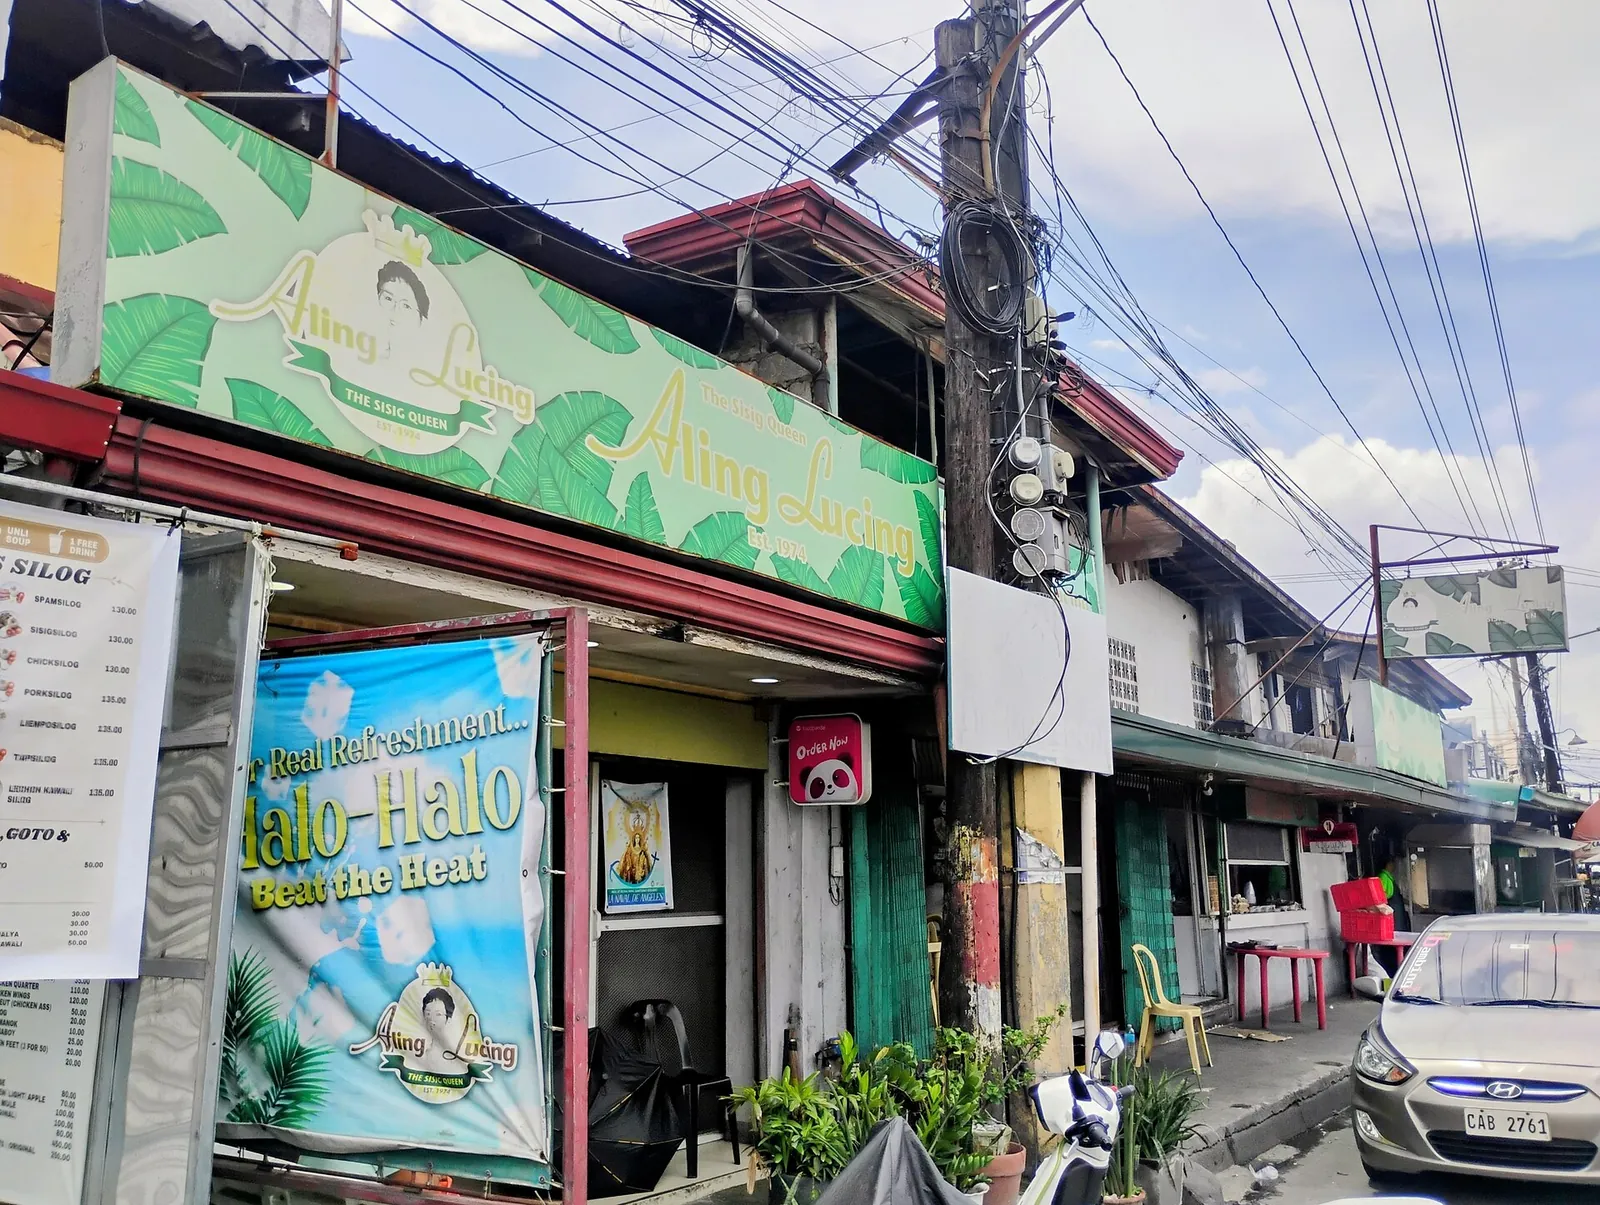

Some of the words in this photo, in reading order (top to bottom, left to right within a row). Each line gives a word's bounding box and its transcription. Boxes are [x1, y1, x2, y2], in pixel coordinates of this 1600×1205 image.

[213, 255, 377, 365] Aling
[408, 323, 534, 421] Lucing
[345, 387, 371, 408] THE
[374, 399, 406, 420] SISIG
[408, 411, 448, 431] QUEEN
[701, 382, 729, 411] The
[731, 399, 764, 430] Sisig
[767, 415, 808, 447] Queen
[396, 425, 421, 441] 1974
[586, 367, 770, 525] Aling
[777, 437, 914, 577] Lucing
[7, 526, 29, 537] UNLI
[6, 535, 31, 546] SOUP
[70, 537, 75, 546] 1
[77, 538, 99, 549] FREE
[747, 526, 773, 551] Est.
[777, 536, 808, 563] 1974
[70, 546, 97, 557] DRINK
[10, 558, 92, 585] SILOG
[34, 595, 82, 608] SPAMSILOG
[112, 606, 137, 615] 130.00
[30, 626, 78, 638] SISIGSILOG
[108, 635, 134, 645] 130.00
[27, 657, 79, 669] CHICKSILOG
[105, 665, 130, 674] 130.00
[24, 688, 72, 699] PORKSILOG
[101, 695, 127, 704] 135.00
[270, 739, 323, 780] Real
[329, 703, 529, 768] Refreshment...
[6, 827, 55, 841] GOTO
[57, 829, 70, 842] &
[84, 861, 104, 869] 50.00
[250, 870, 328, 910] Beat
[333, 863, 393, 899] the
[398, 844, 488, 890] Heat
[71, 910, 91, 918] 30.00
[13, 981, 40, 990] QUARTER
[70, 986, 90, 995] 110.00
[12, 991, 31, 999] WINGS
[69, 996, 89, 1005] 120.00
[11, 1000, 38, 1010] (CHICKEN
[38, 1003, 52, 1012] ASS)
[71, 1007, 87, 1016] 50.00
[70, 1017, 86, 1026] 20.00
[69, 1027, 85, 1036] 10.00
[350, 1004, 426, 1058] Aling
[443, 1013, 516, 1068] Lucing
[6, 1040, 20, 1049] FEET
[27, 1042, 39, 1052] FOR
[67, 1037, 84, 1047] 25.00
[66, 1047, 83, 1057] 20.00
[65, 1058, 82, 1067] 20.00
[407, 1072, 423, 1082] THE
[442, 1077, 464, 1086] QUEEN
[27, 1093, 46, 1104] APPLE
[60, 1098, 76, 1109] 70.00
[55, 1108, 75, 1119] 100.00
[1467, 1113, 1496, 1131] CAB
[1507, 1116, 1547, 1134] 2761
